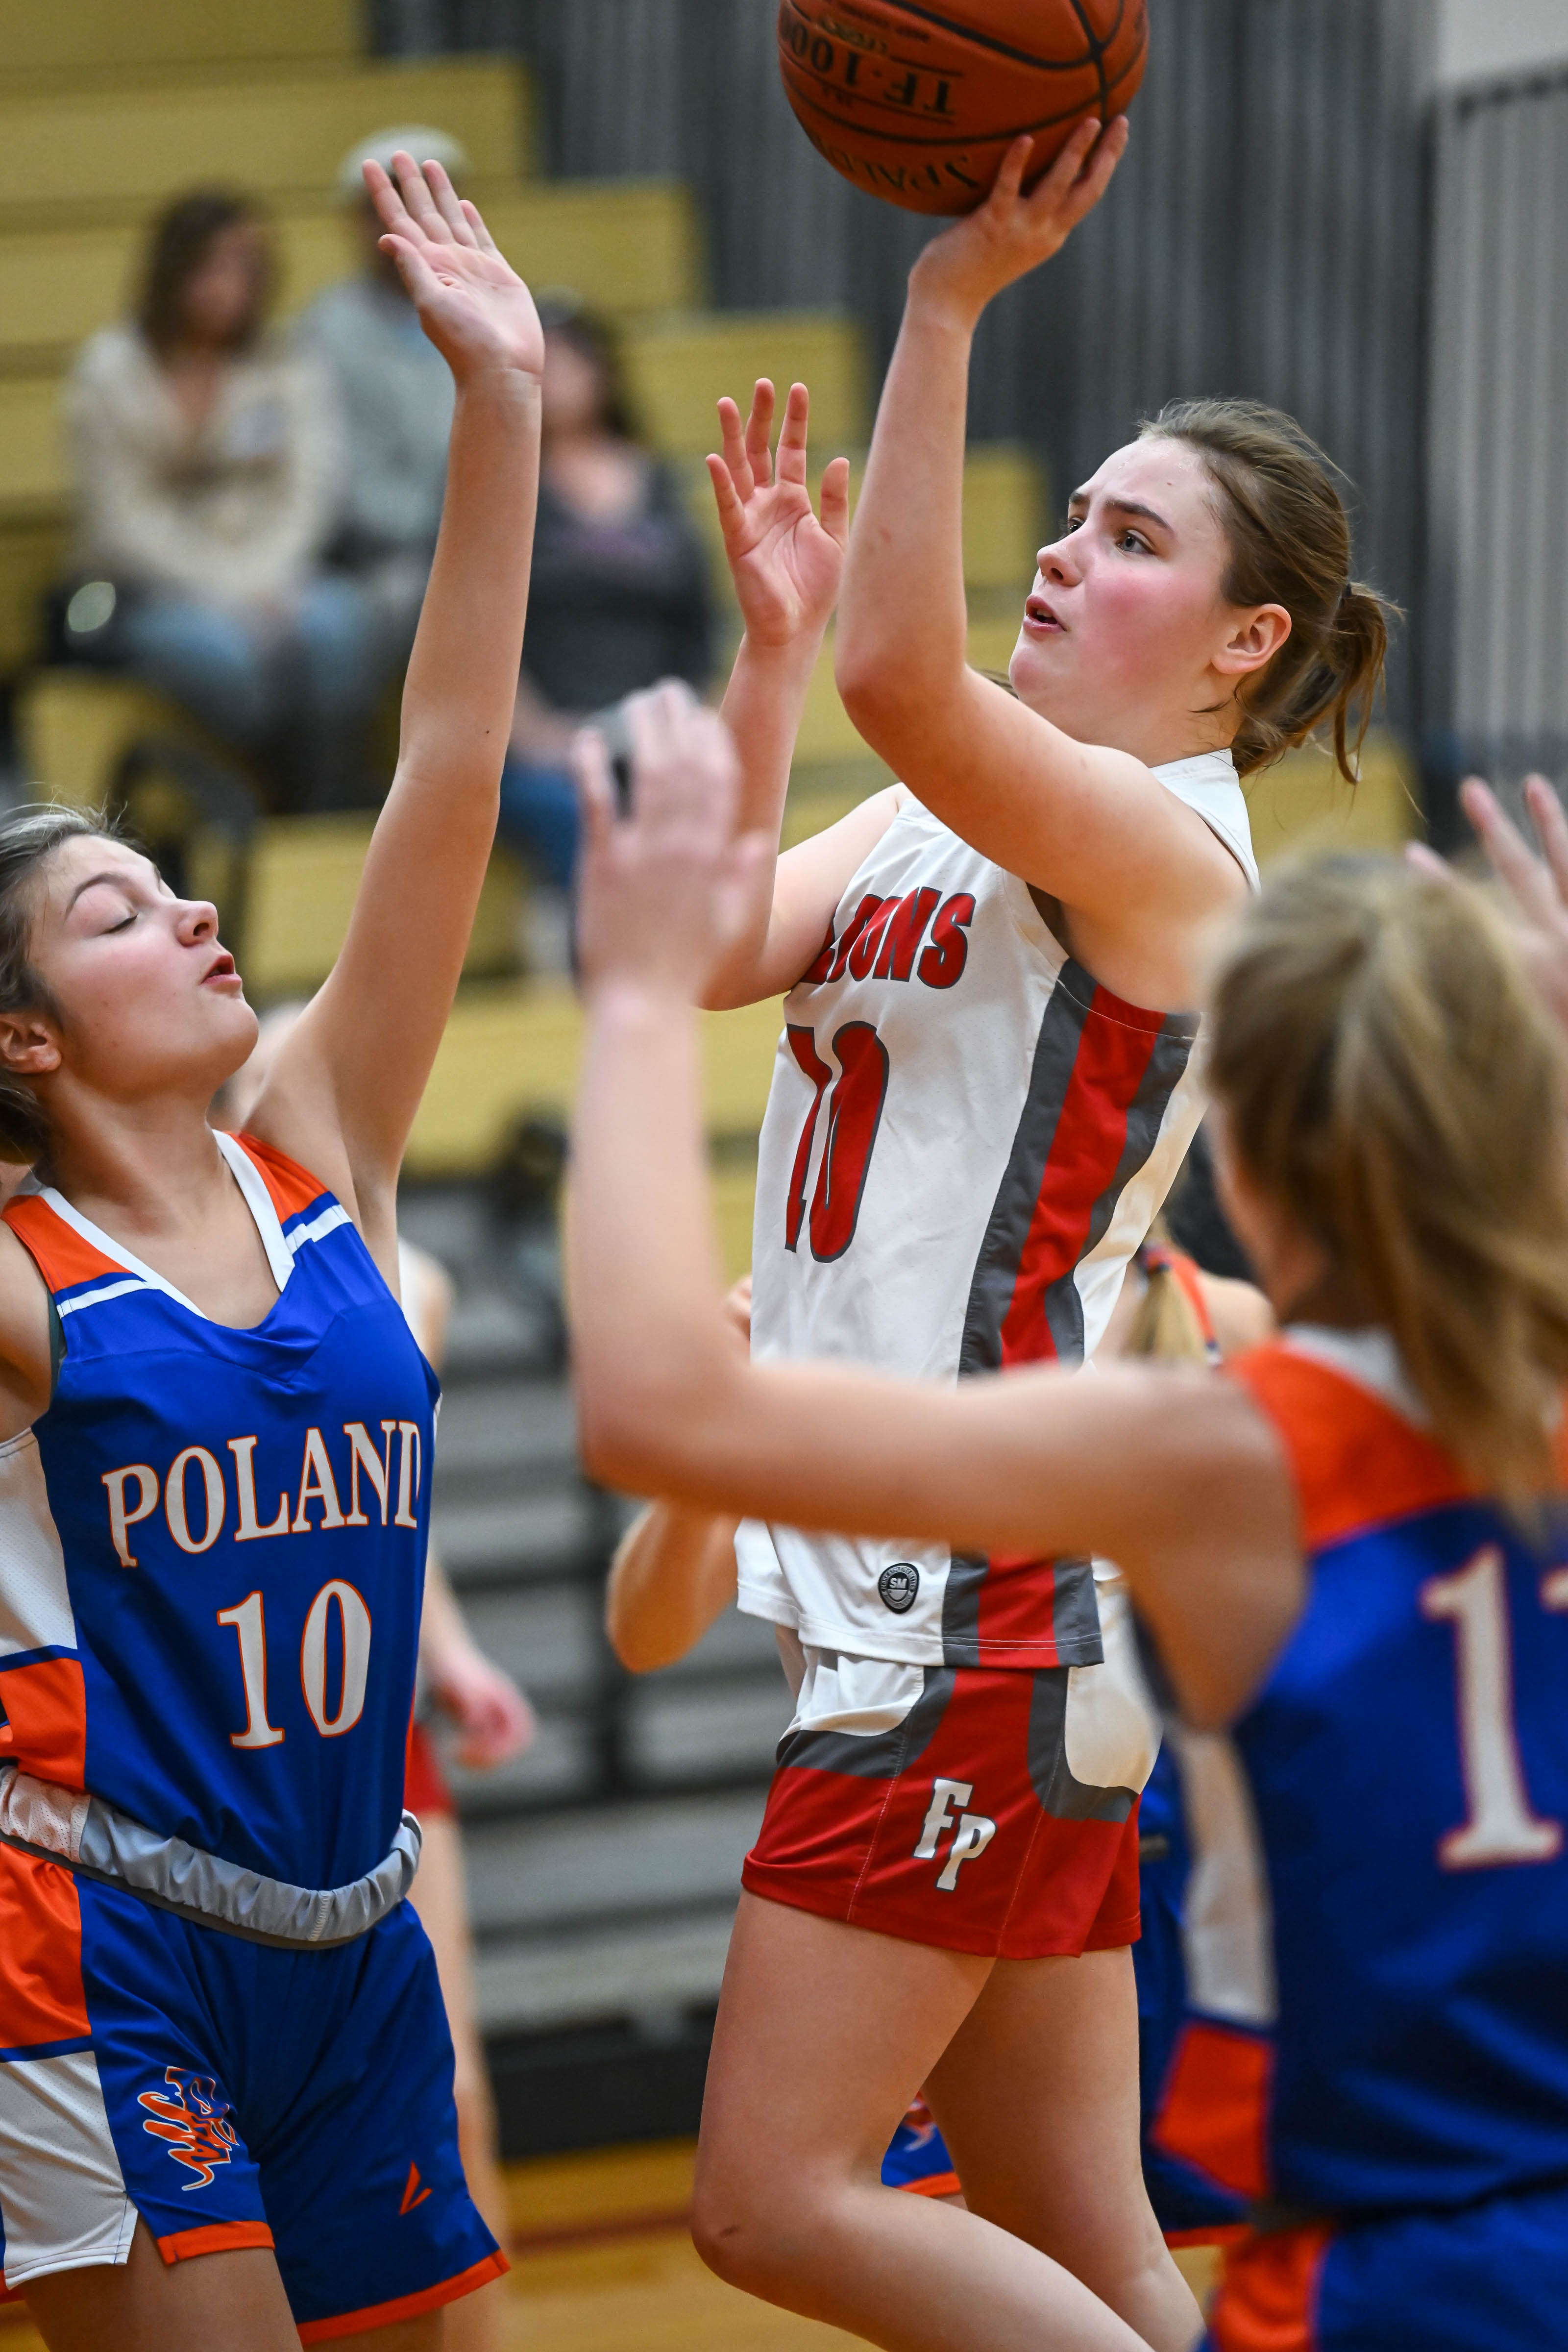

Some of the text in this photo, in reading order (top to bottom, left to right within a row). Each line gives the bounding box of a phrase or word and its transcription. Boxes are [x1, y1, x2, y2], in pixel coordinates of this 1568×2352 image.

[784, 1020, 889, 1263] 10
[101, 1420, 422, 1568] POLAND
[889, 1578, 907, 1589] SM
[217, 1578, 372, 1750] 10
[1418, 1542, 1568, 1874] 1
[912, 1777, 998, 1891] FP
